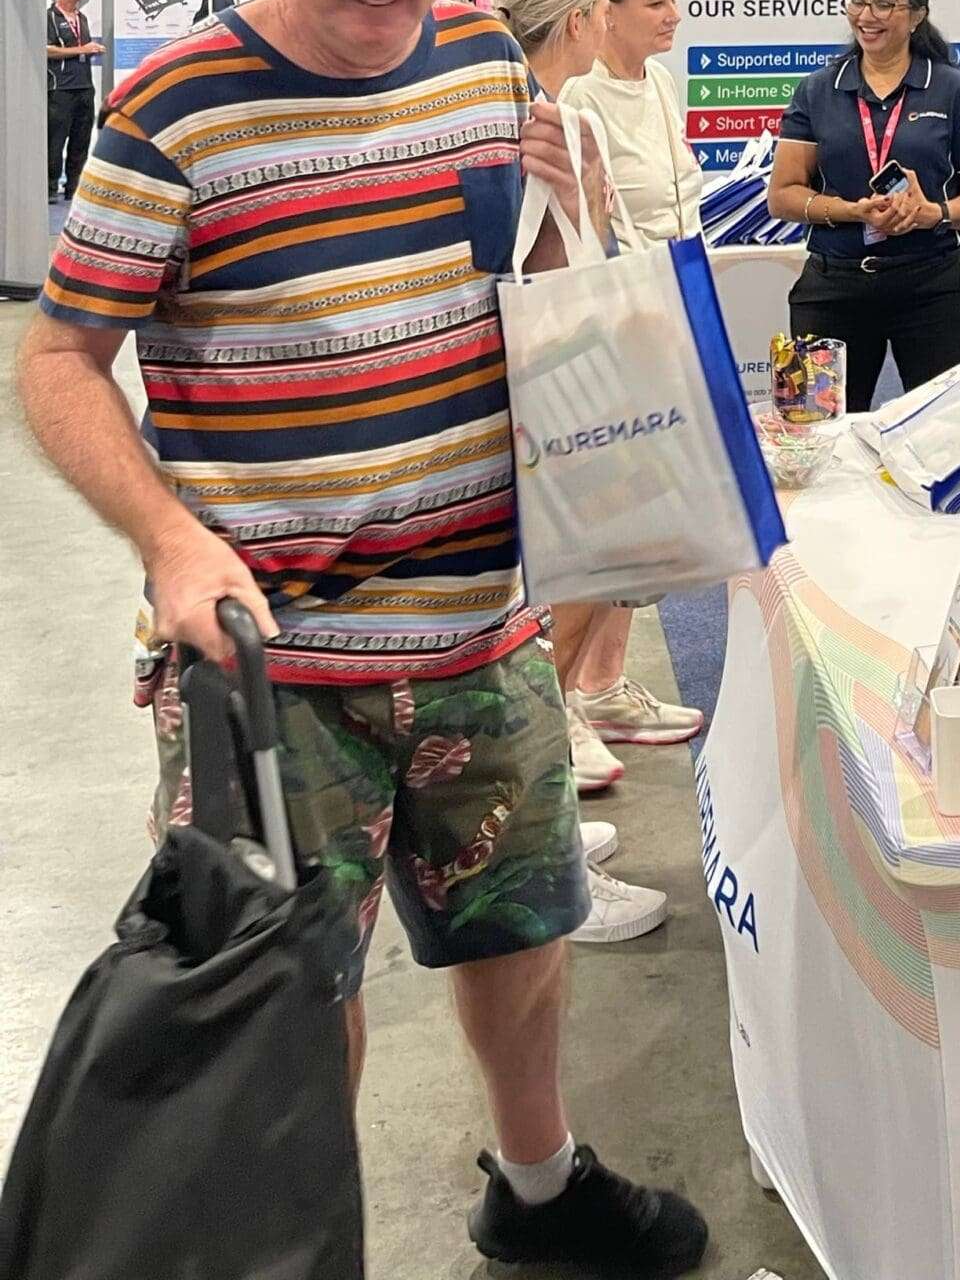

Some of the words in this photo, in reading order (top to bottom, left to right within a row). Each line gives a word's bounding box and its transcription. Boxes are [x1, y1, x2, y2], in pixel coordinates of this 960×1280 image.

[688, 0, 735, 17] OUR
[717, 52, 791, 69] Supported
[717, 85, 777, 99] In-Home
[716, 116, 754, 131] Short
[542, 406, 687, 458] KUREMARA
